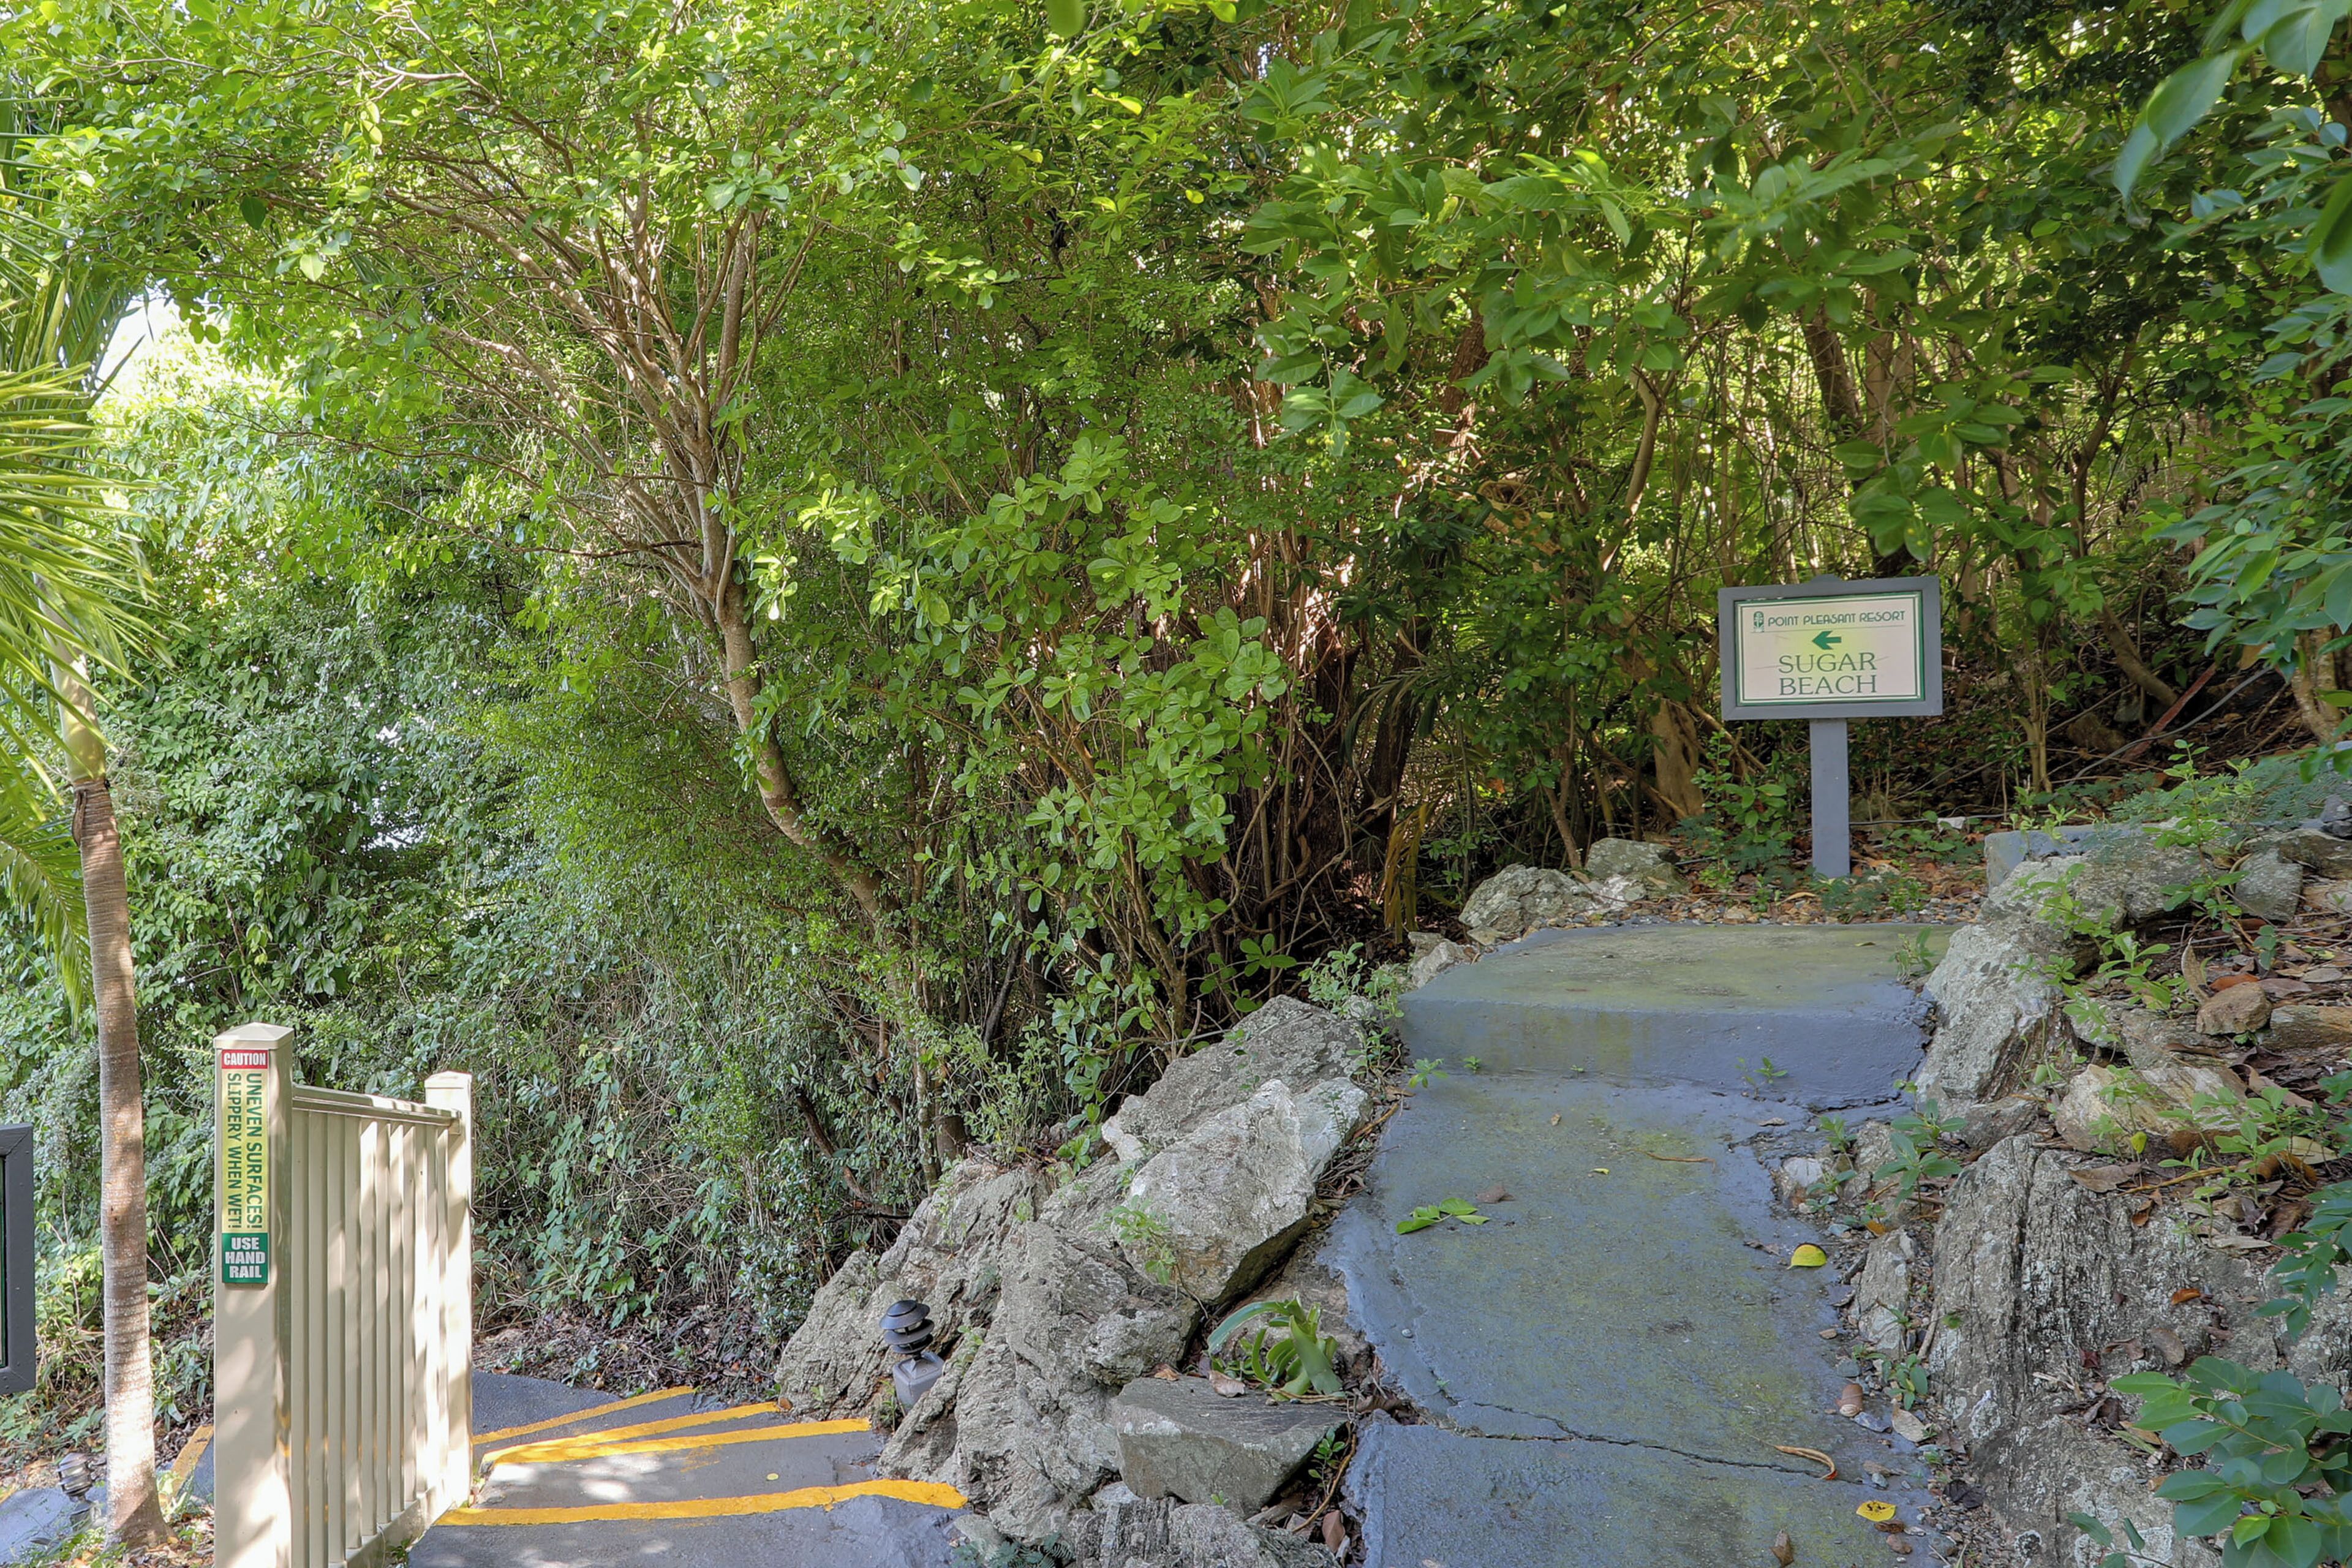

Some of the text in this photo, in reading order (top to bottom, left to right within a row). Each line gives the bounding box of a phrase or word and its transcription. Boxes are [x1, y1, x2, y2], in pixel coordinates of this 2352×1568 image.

[1768, 611, 1905, 627] POINT PLEASANT RESORT
[1778, 652, 1877, 673] SUGAR
[1779, 675, 1877, 696] BEACH
[224, 1052, 266, 1066] CAUTION
[227, 1073, 241, 1228] SLIPPERY WHEN WET!
[246, 1073, 262, 1228] UNEVEN SURFACES!
[232, 1237, 259, 1250] USE
[225, 1251, 265, 1264] HAND
[230, 1265, 262, 1278] RAIL
